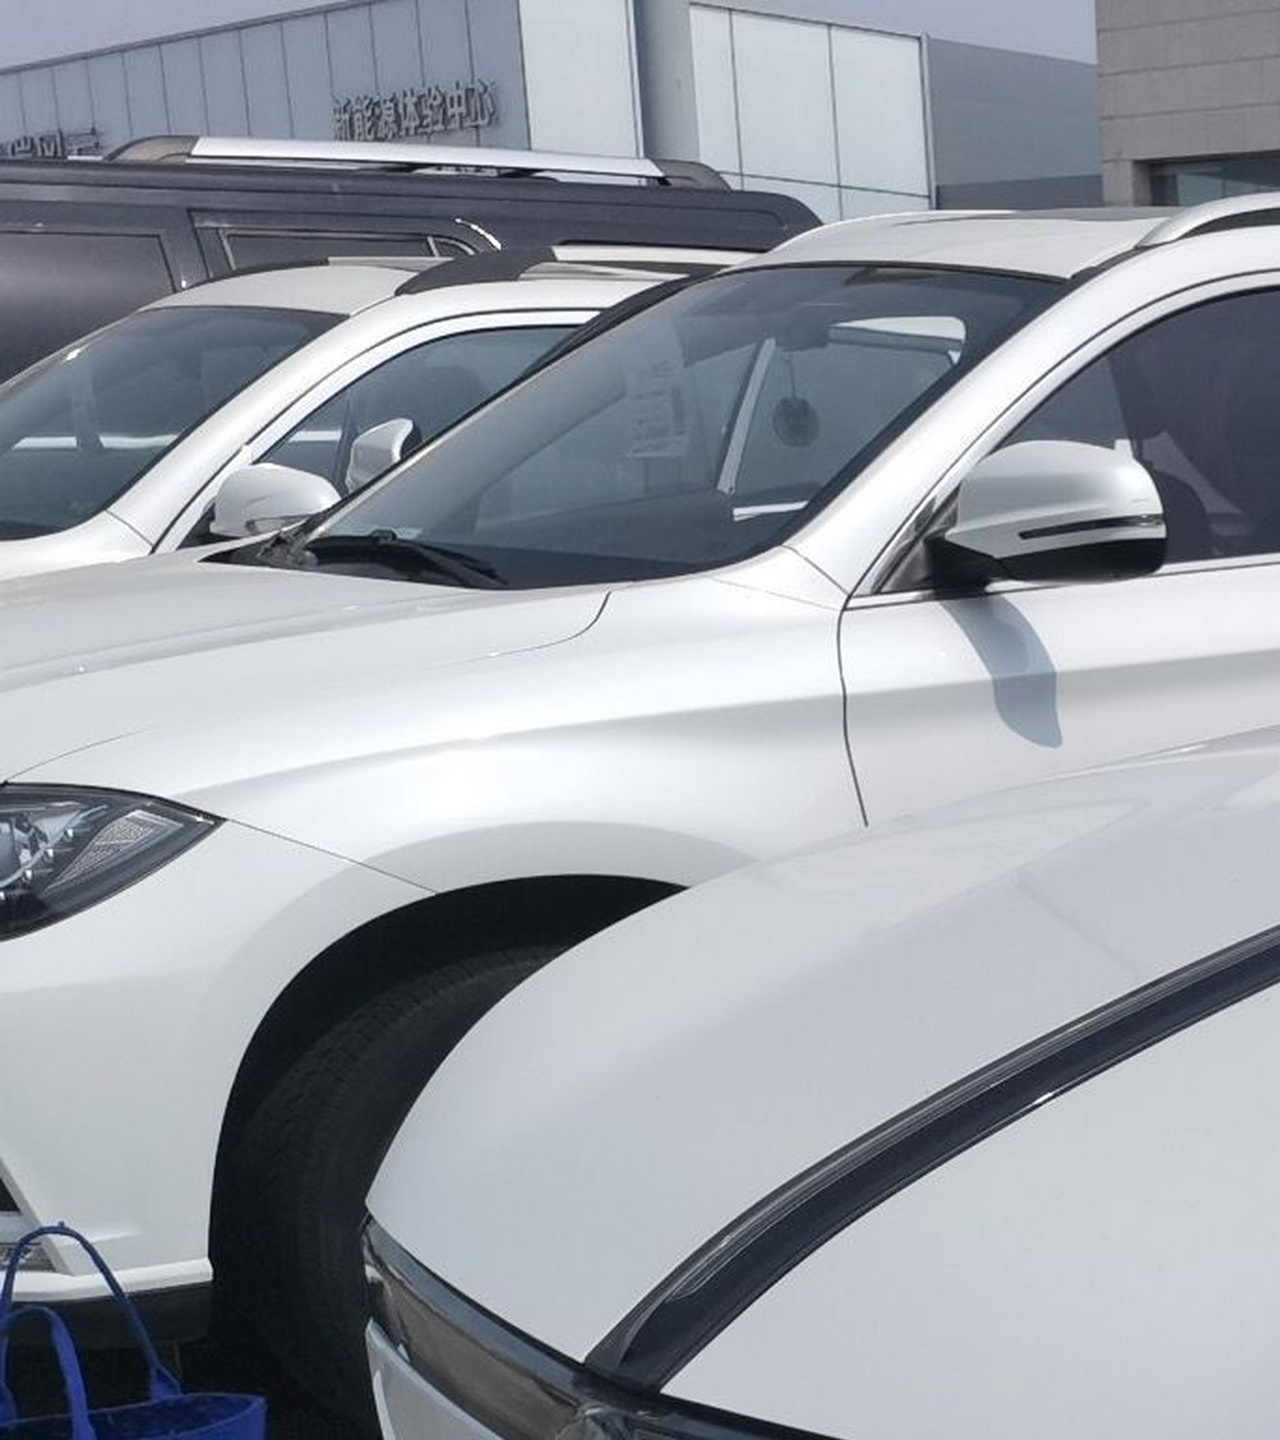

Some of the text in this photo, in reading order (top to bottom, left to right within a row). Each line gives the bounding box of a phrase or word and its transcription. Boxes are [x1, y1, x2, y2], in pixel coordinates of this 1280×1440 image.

[333, 79, 497, 142] 新能源体验中心
